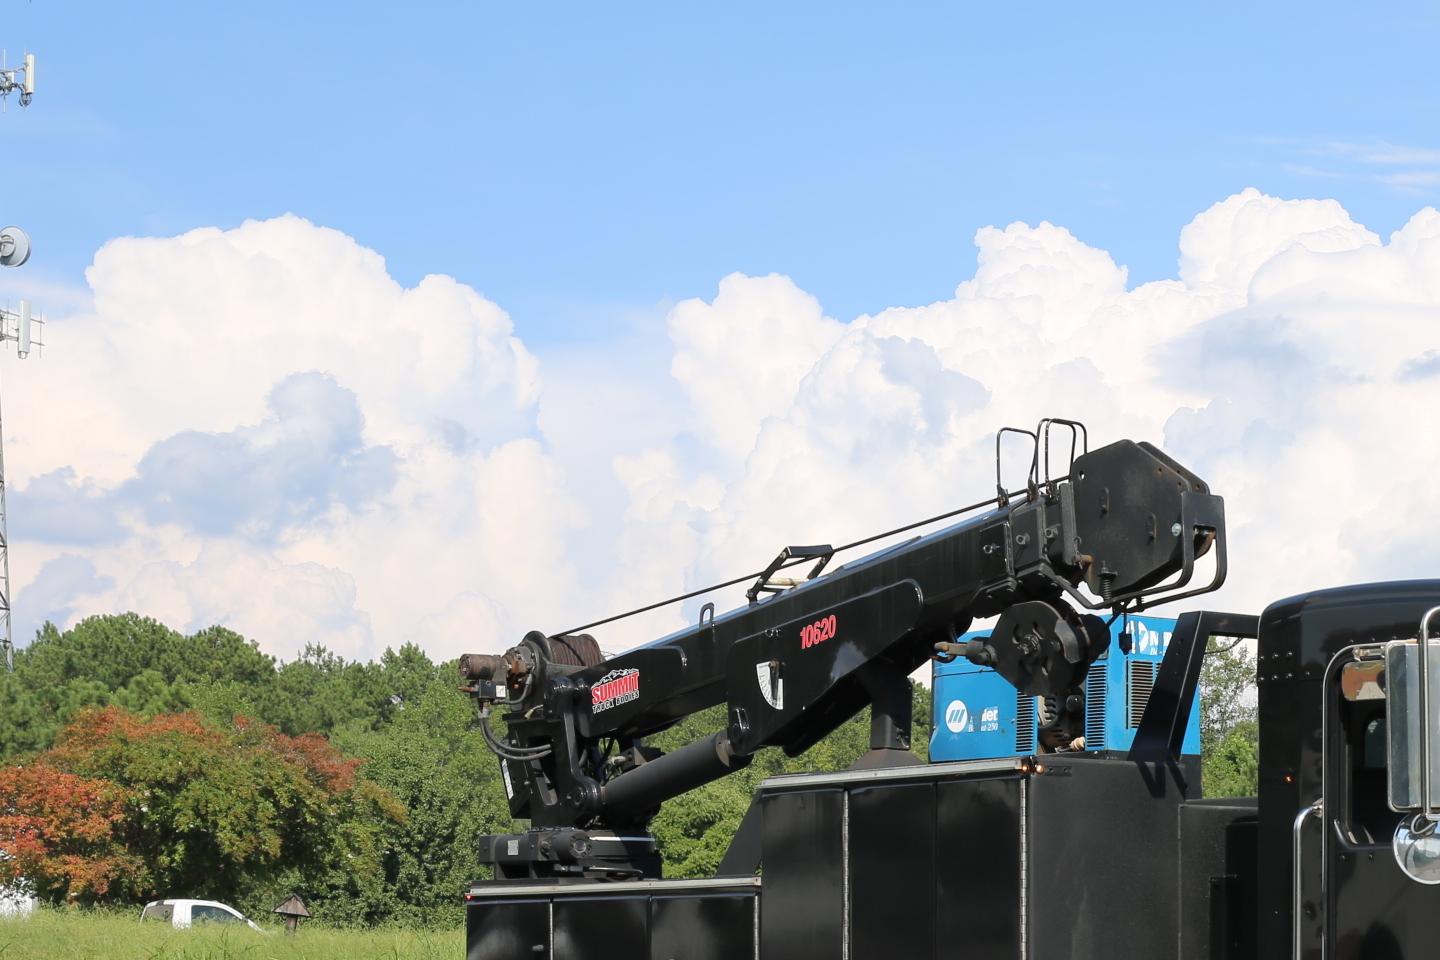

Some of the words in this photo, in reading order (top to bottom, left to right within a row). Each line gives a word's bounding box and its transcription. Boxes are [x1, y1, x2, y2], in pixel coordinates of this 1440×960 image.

[800, 614, 836, 650] 10620
[591, 671, 640, 705] SUMMIT
[592, 698, 615, 714] TRUCK
[615, 689, 640, 706] BODIES
